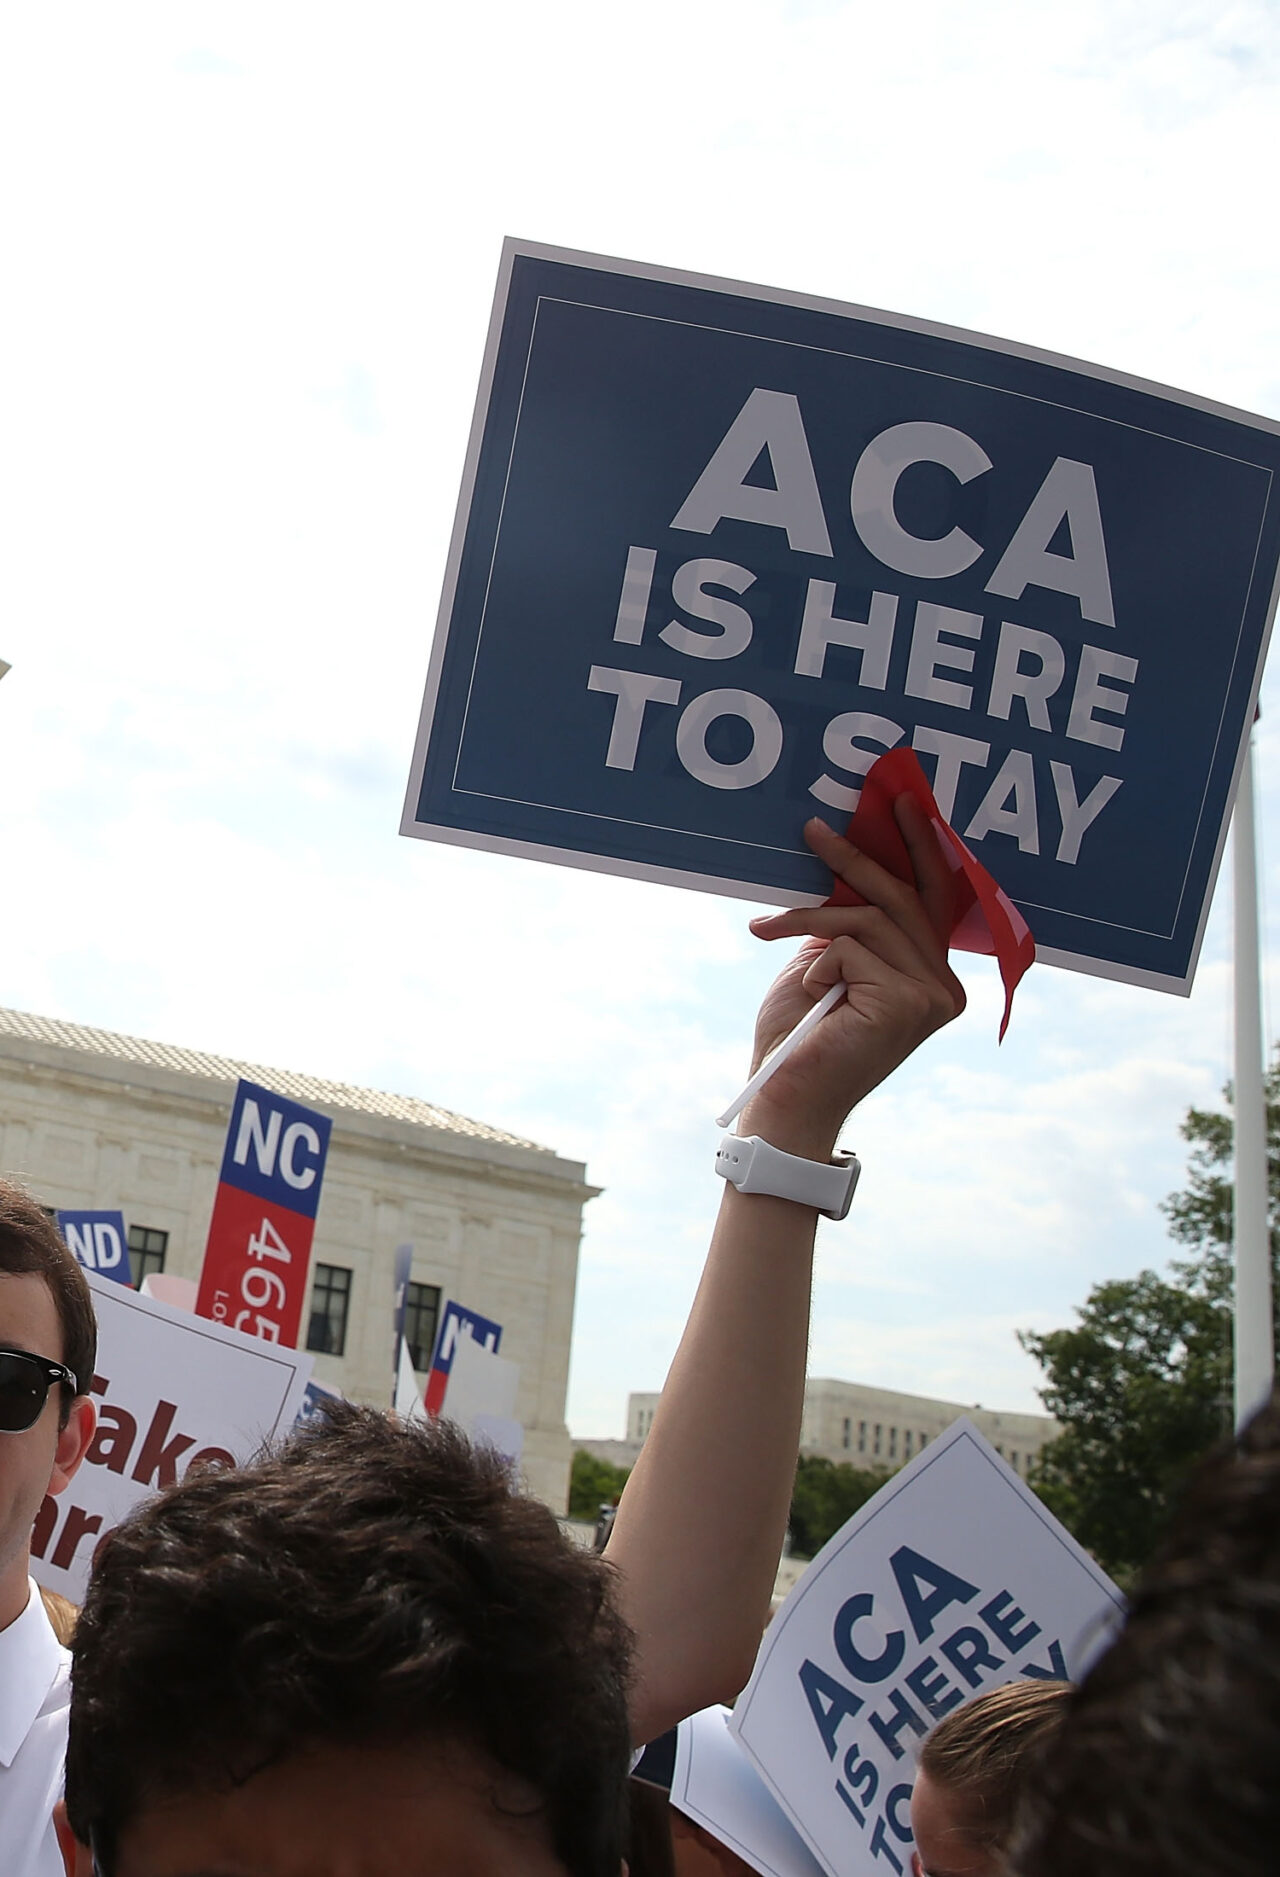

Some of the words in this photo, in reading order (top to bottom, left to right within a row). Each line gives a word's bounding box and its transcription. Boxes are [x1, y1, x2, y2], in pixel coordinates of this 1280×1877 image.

[668, 387, 1116, 628] ACA
[612, 545, 758, 661] IS
[793, 577, 1140, 752] HERE
[587, 664, 783, 790] TO
[808, 711, 1124, 865] STAY
[66, 1222, 122, 1269] ND
[233, 1098, 320, 1191] NC
[797, 1545, 981, 1762] ACA
[835, 1743, 879, 1830] IS
[868, 1589, 1042, 1761] HERE
